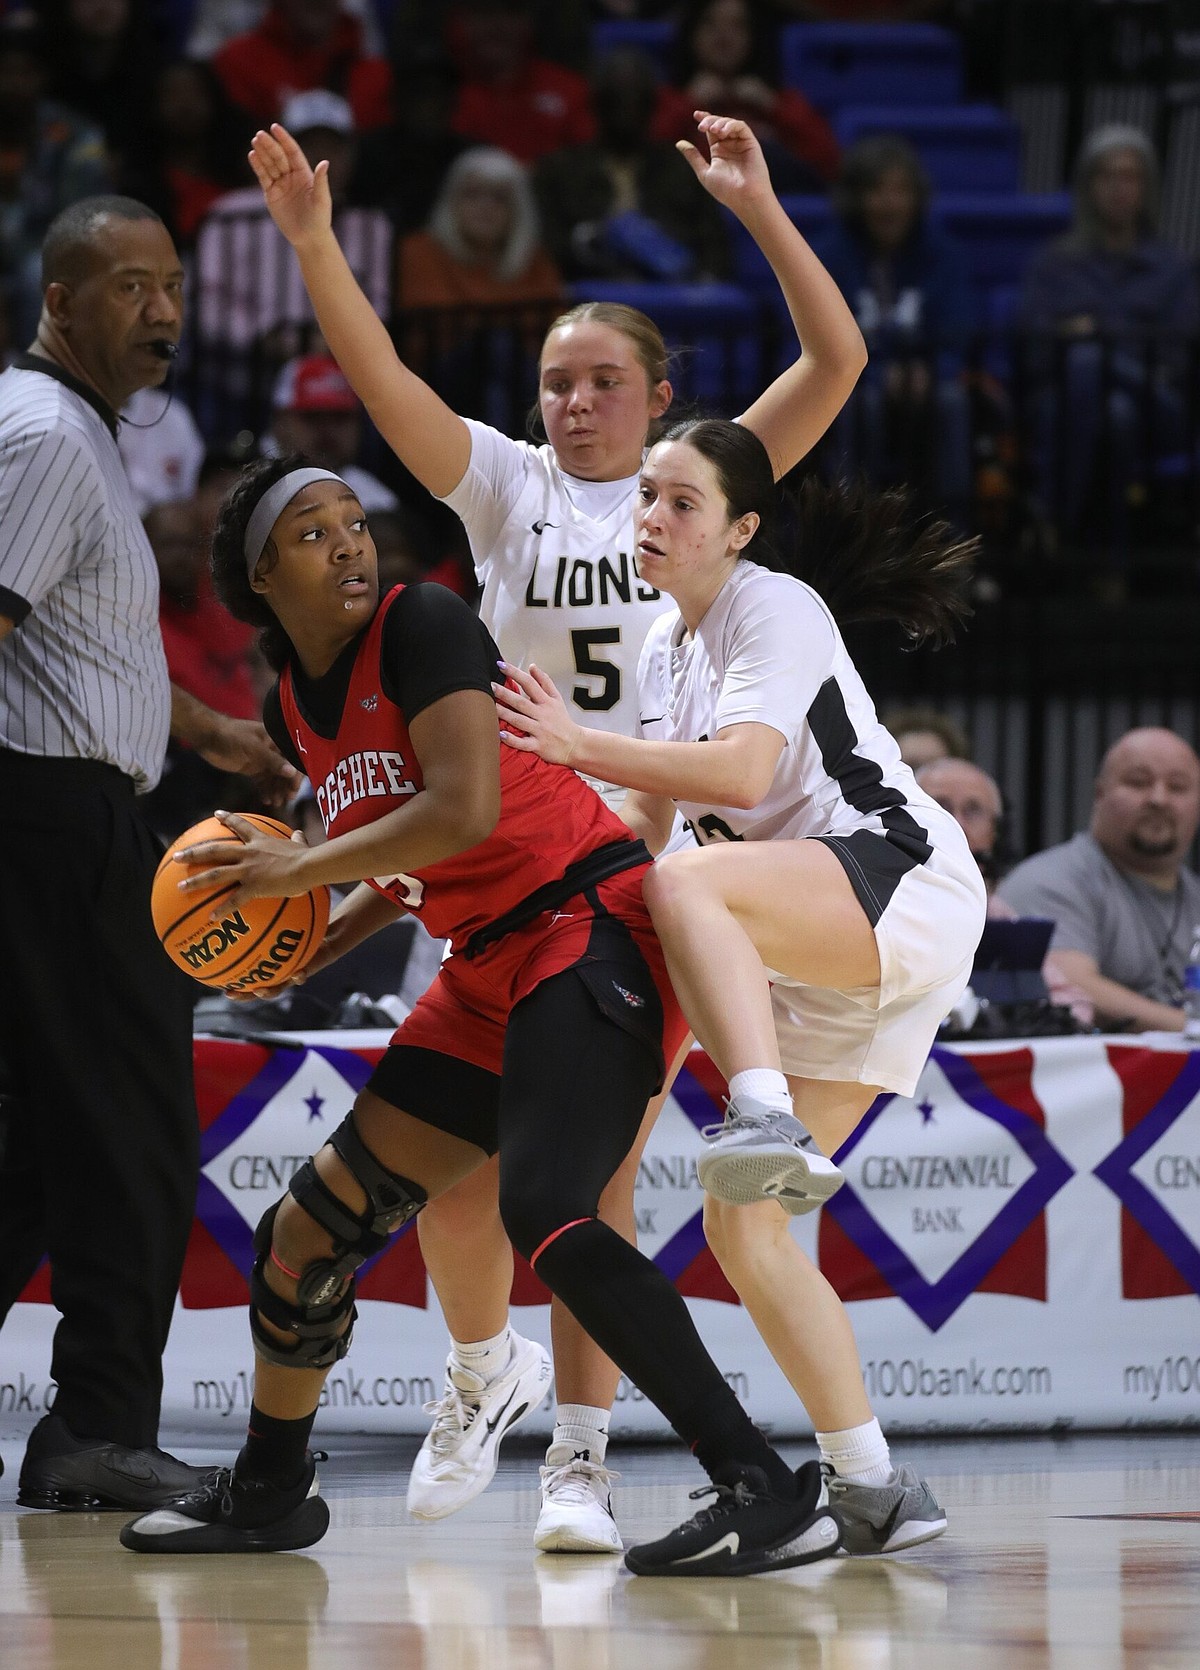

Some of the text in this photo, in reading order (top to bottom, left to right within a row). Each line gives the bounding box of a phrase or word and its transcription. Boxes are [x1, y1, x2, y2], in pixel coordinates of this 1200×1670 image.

[525, 552, 661, 608] LIONS
[568, 624, 623, 712] 5
[179, 909, 252, 970] NCAA
[229, 1154, 304, 1190] CENT
[861, 1154, 1015, 1189] CENTENNIAL
[911, 1206, 965, 1234] BANK
[193, 1368, 437, 1417] my1ank.com
[863, 1357, 1051, 1397] 100bank.com
